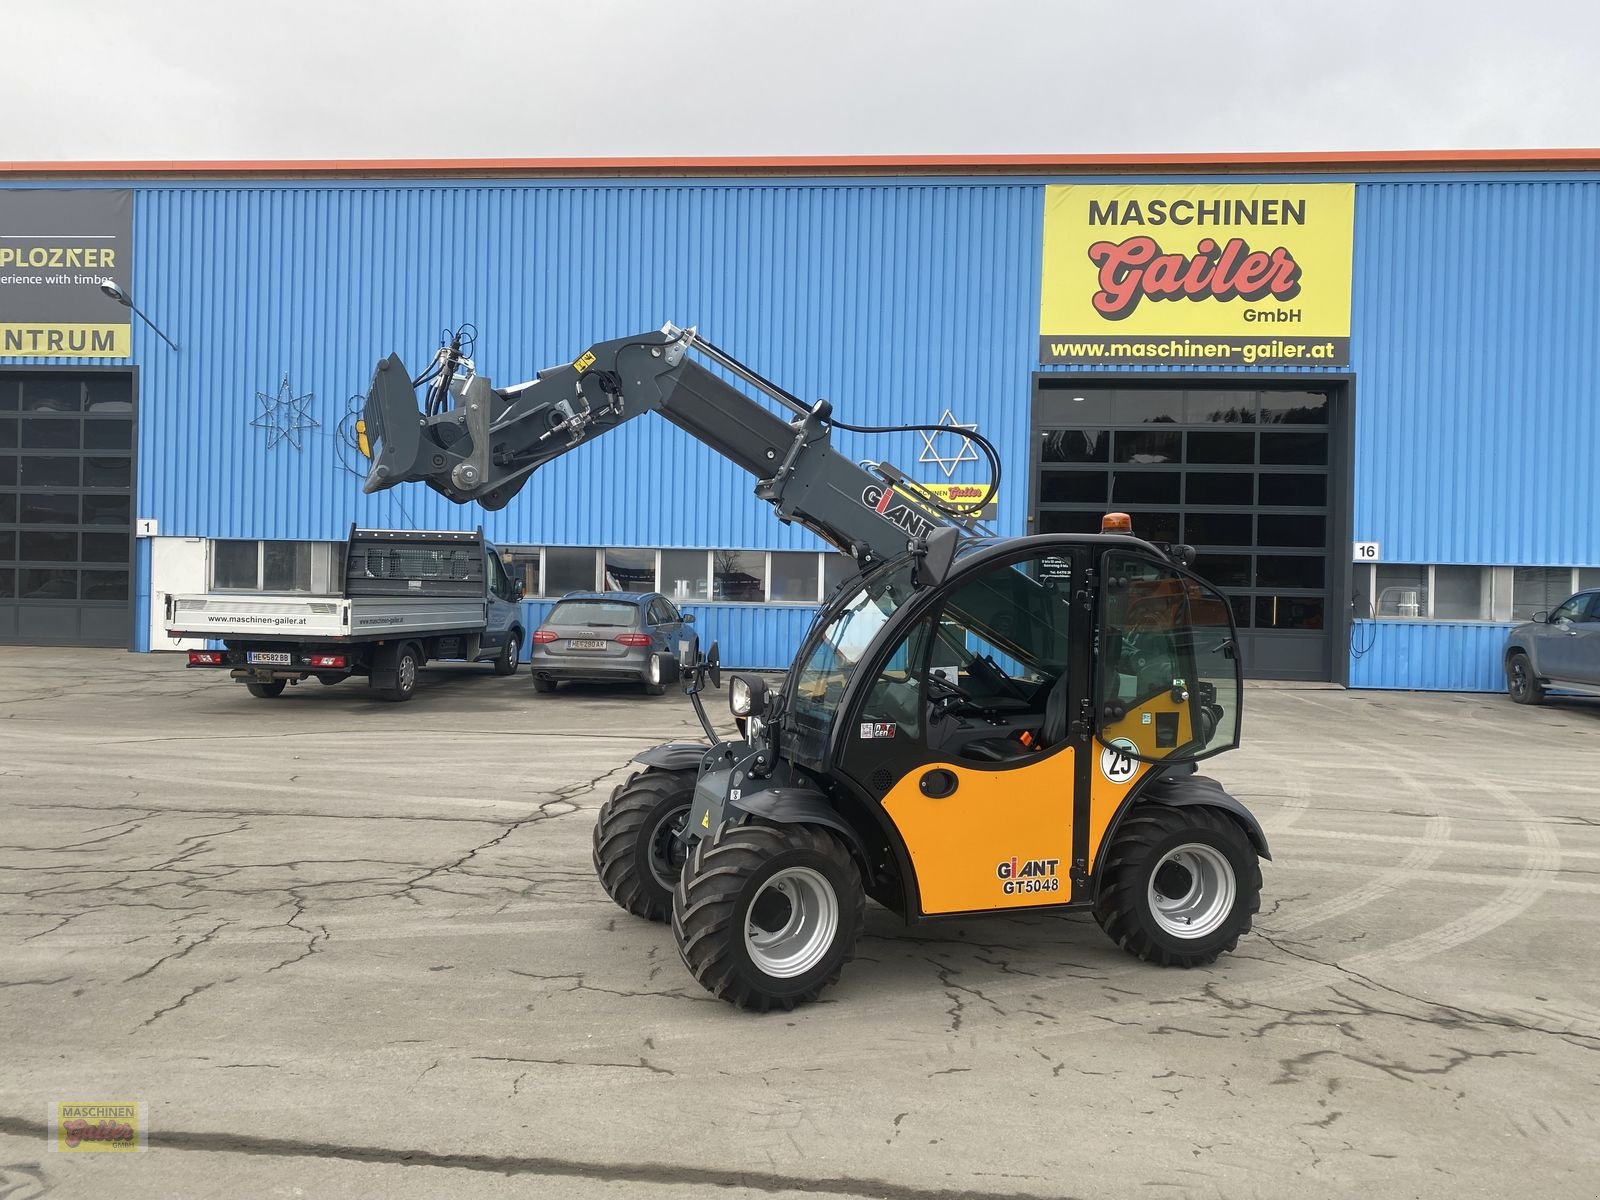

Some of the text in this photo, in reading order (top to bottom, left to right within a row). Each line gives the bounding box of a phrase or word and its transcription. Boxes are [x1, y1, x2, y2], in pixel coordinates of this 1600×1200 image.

[1088, 199, 1306, 226] MASCHINEN
[45, 274, 71, 284] with
[1088, 236, 1302, 321] Gailer
[1243, 309, 1302, 323] GmbH
[1050, 339, 1335, 362] www.maschinen-gailer.at
[144, 521, 150, 533] 1
[1359, 545, 1375, 558] 16
[1109, 746, 1132, 775] 25
[1003, 878, 1059, 894] GT5048
